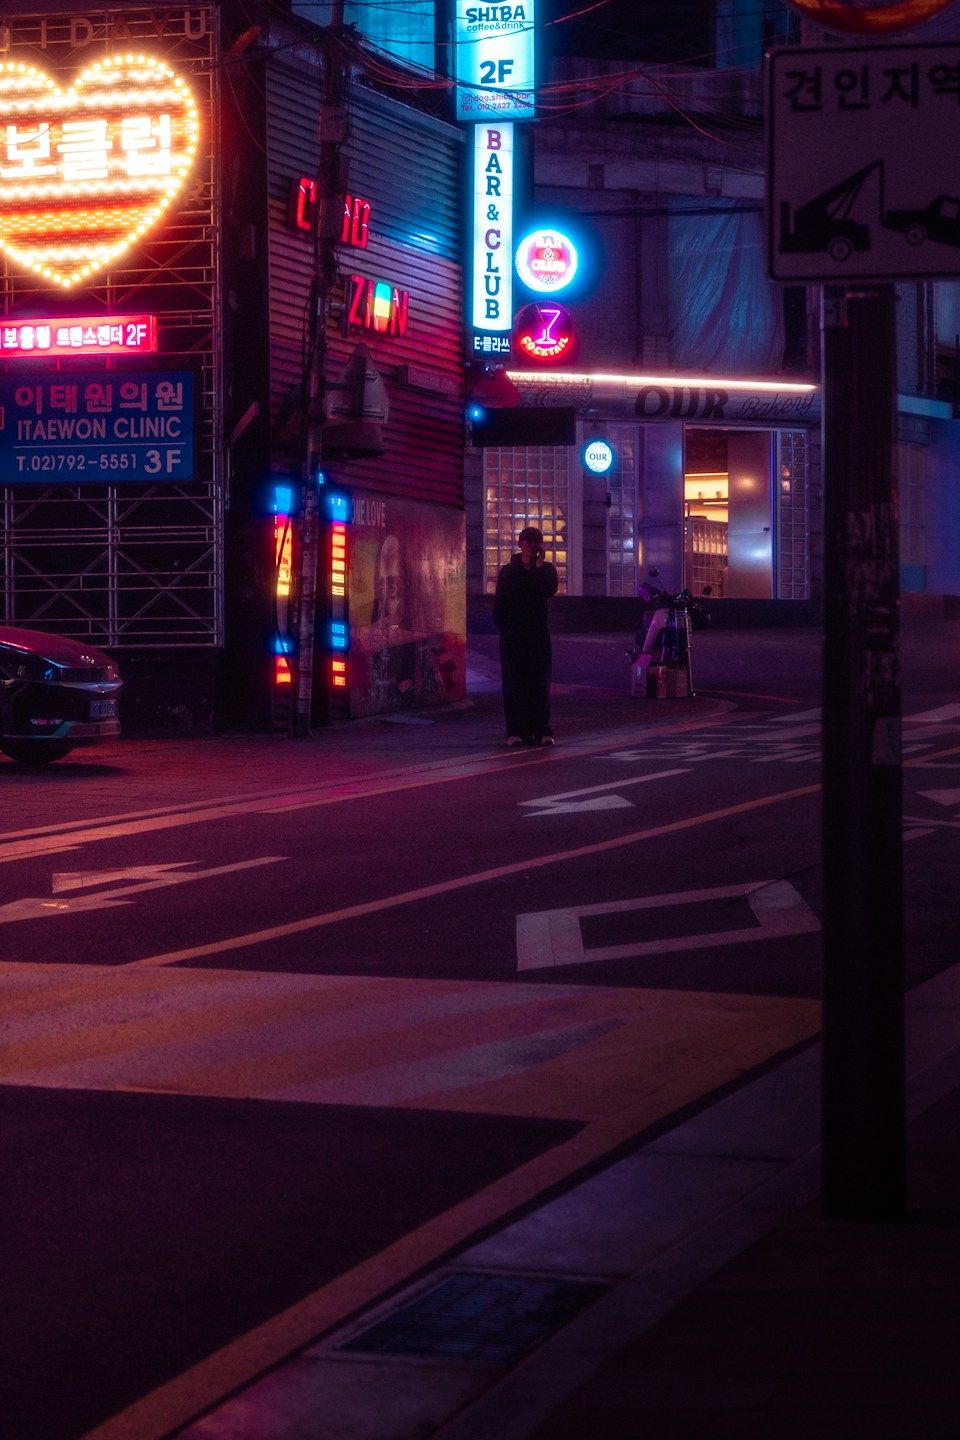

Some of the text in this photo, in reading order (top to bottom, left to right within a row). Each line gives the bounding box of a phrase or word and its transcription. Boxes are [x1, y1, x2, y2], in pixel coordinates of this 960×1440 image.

[466, 5, 526, 24] SHIBA
[479, 59, 514, 84] 2F
[485, 129, 502, 197] BAR
[484, 229, 501, 319] CLUB
[126, 323, 147, 346] 2F
[521, 335, 569, 357] COCKTAIL
[14, 382, 184, 414] 이태원의원
[635, 385, 816, 419] OUR Bakery
[16, 416, 182, 441] ITAEWON CLINIC
[144, 449, 182, 474] 3F
[589, 452, 607, 461] OUR
